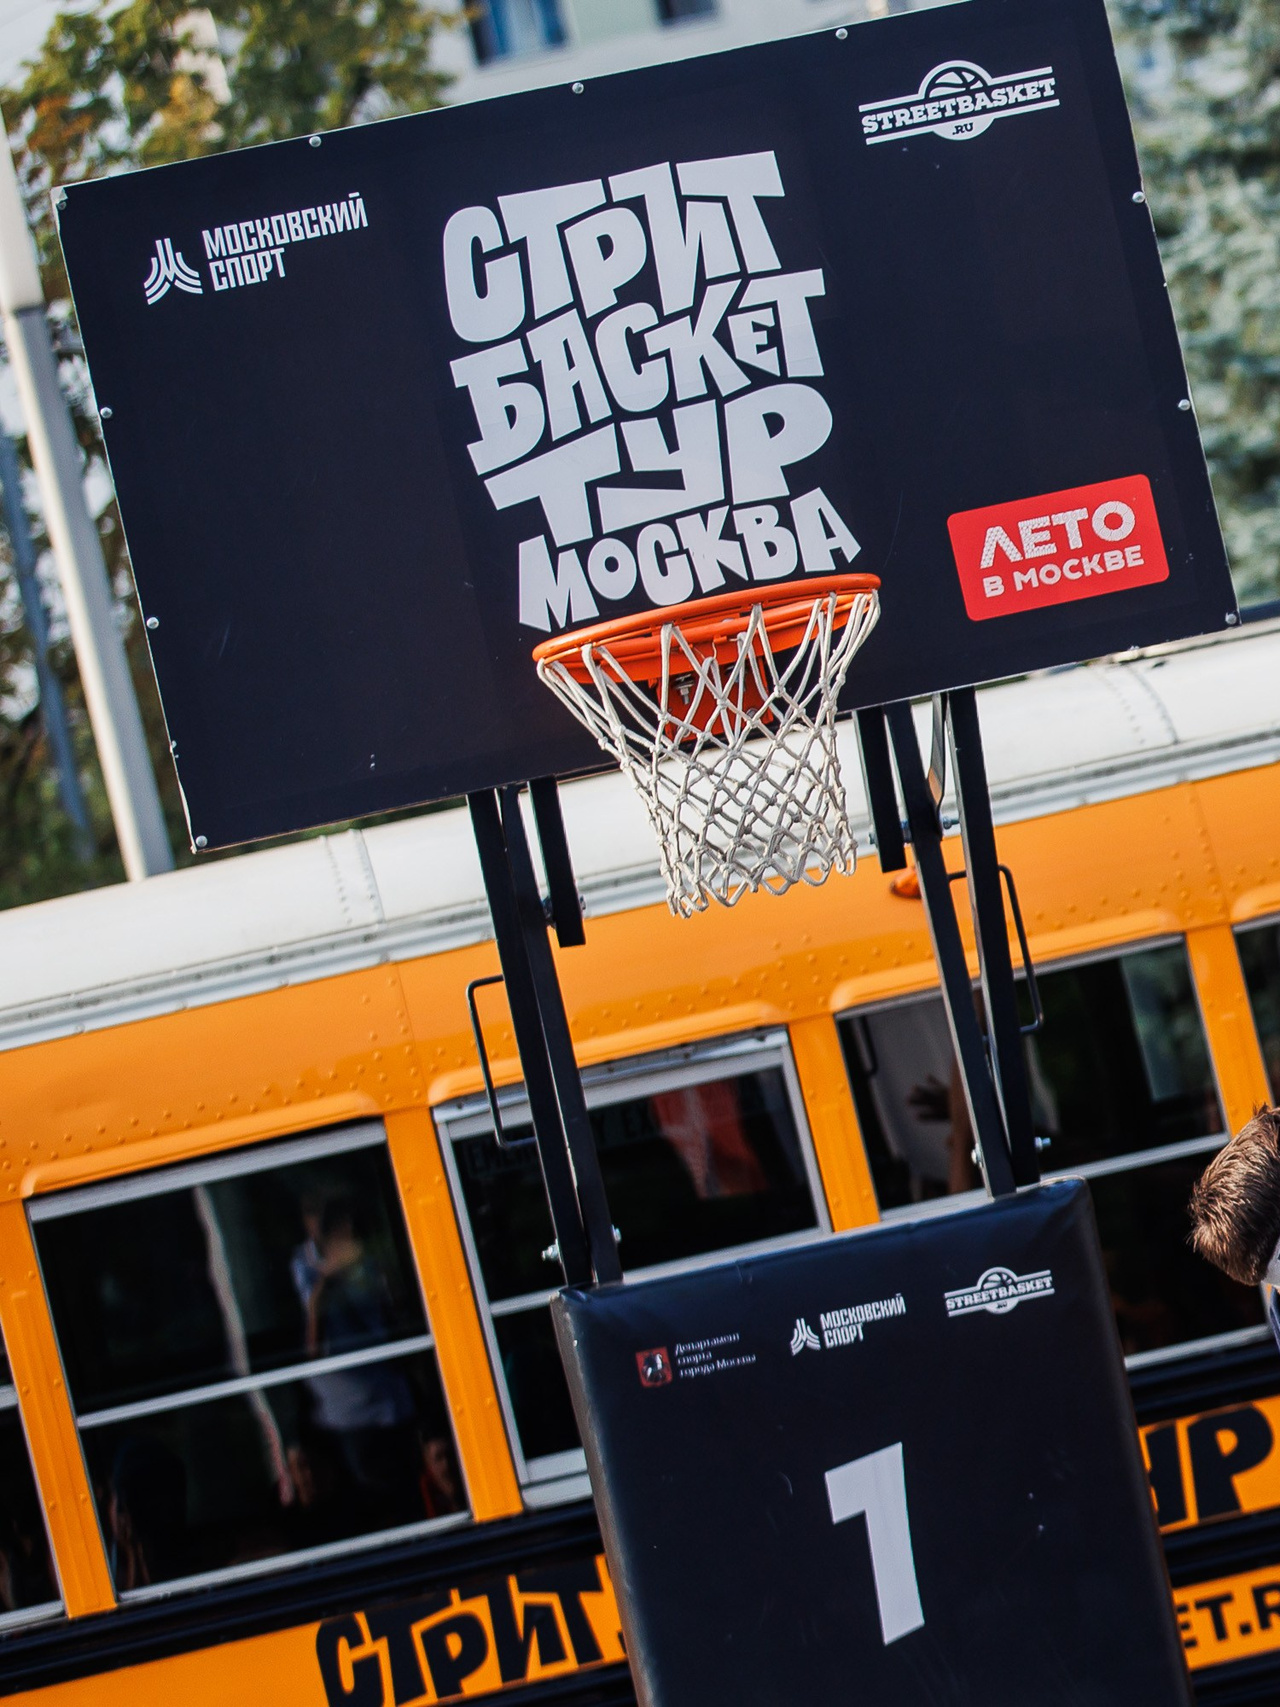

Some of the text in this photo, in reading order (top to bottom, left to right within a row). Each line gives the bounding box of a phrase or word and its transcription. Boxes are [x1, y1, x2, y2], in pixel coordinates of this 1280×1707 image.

[861, 78, 1056, 134] STREETBASKET
[952, 122, 974, 136] .RU
[202, 192, 368, 259] МОСКОВСКИЙ
[443, 150, 785, 343] СТРИТ
[209, 247, 286, 291] СПОРТ
[450, 268, 826, 475] БАСКЕТ
[484, 383, 833, 547] ТУР
[519, 487, 861, 632] МОСКВА
[980, 500, 1136, 569] ЛЕТО
[982, 544, 1145, 598] В МОСКВЕ
[820, 1293, 906, 1331] МОСКОВСКИЙ
[946, 1276, 1053, 1311] STREETBASKET
[824, 1322, 864, 1349] СПОРТ
[825, 1442, 924, 1646] 1
[315, 1555, 604, 1707] СТРИТ
